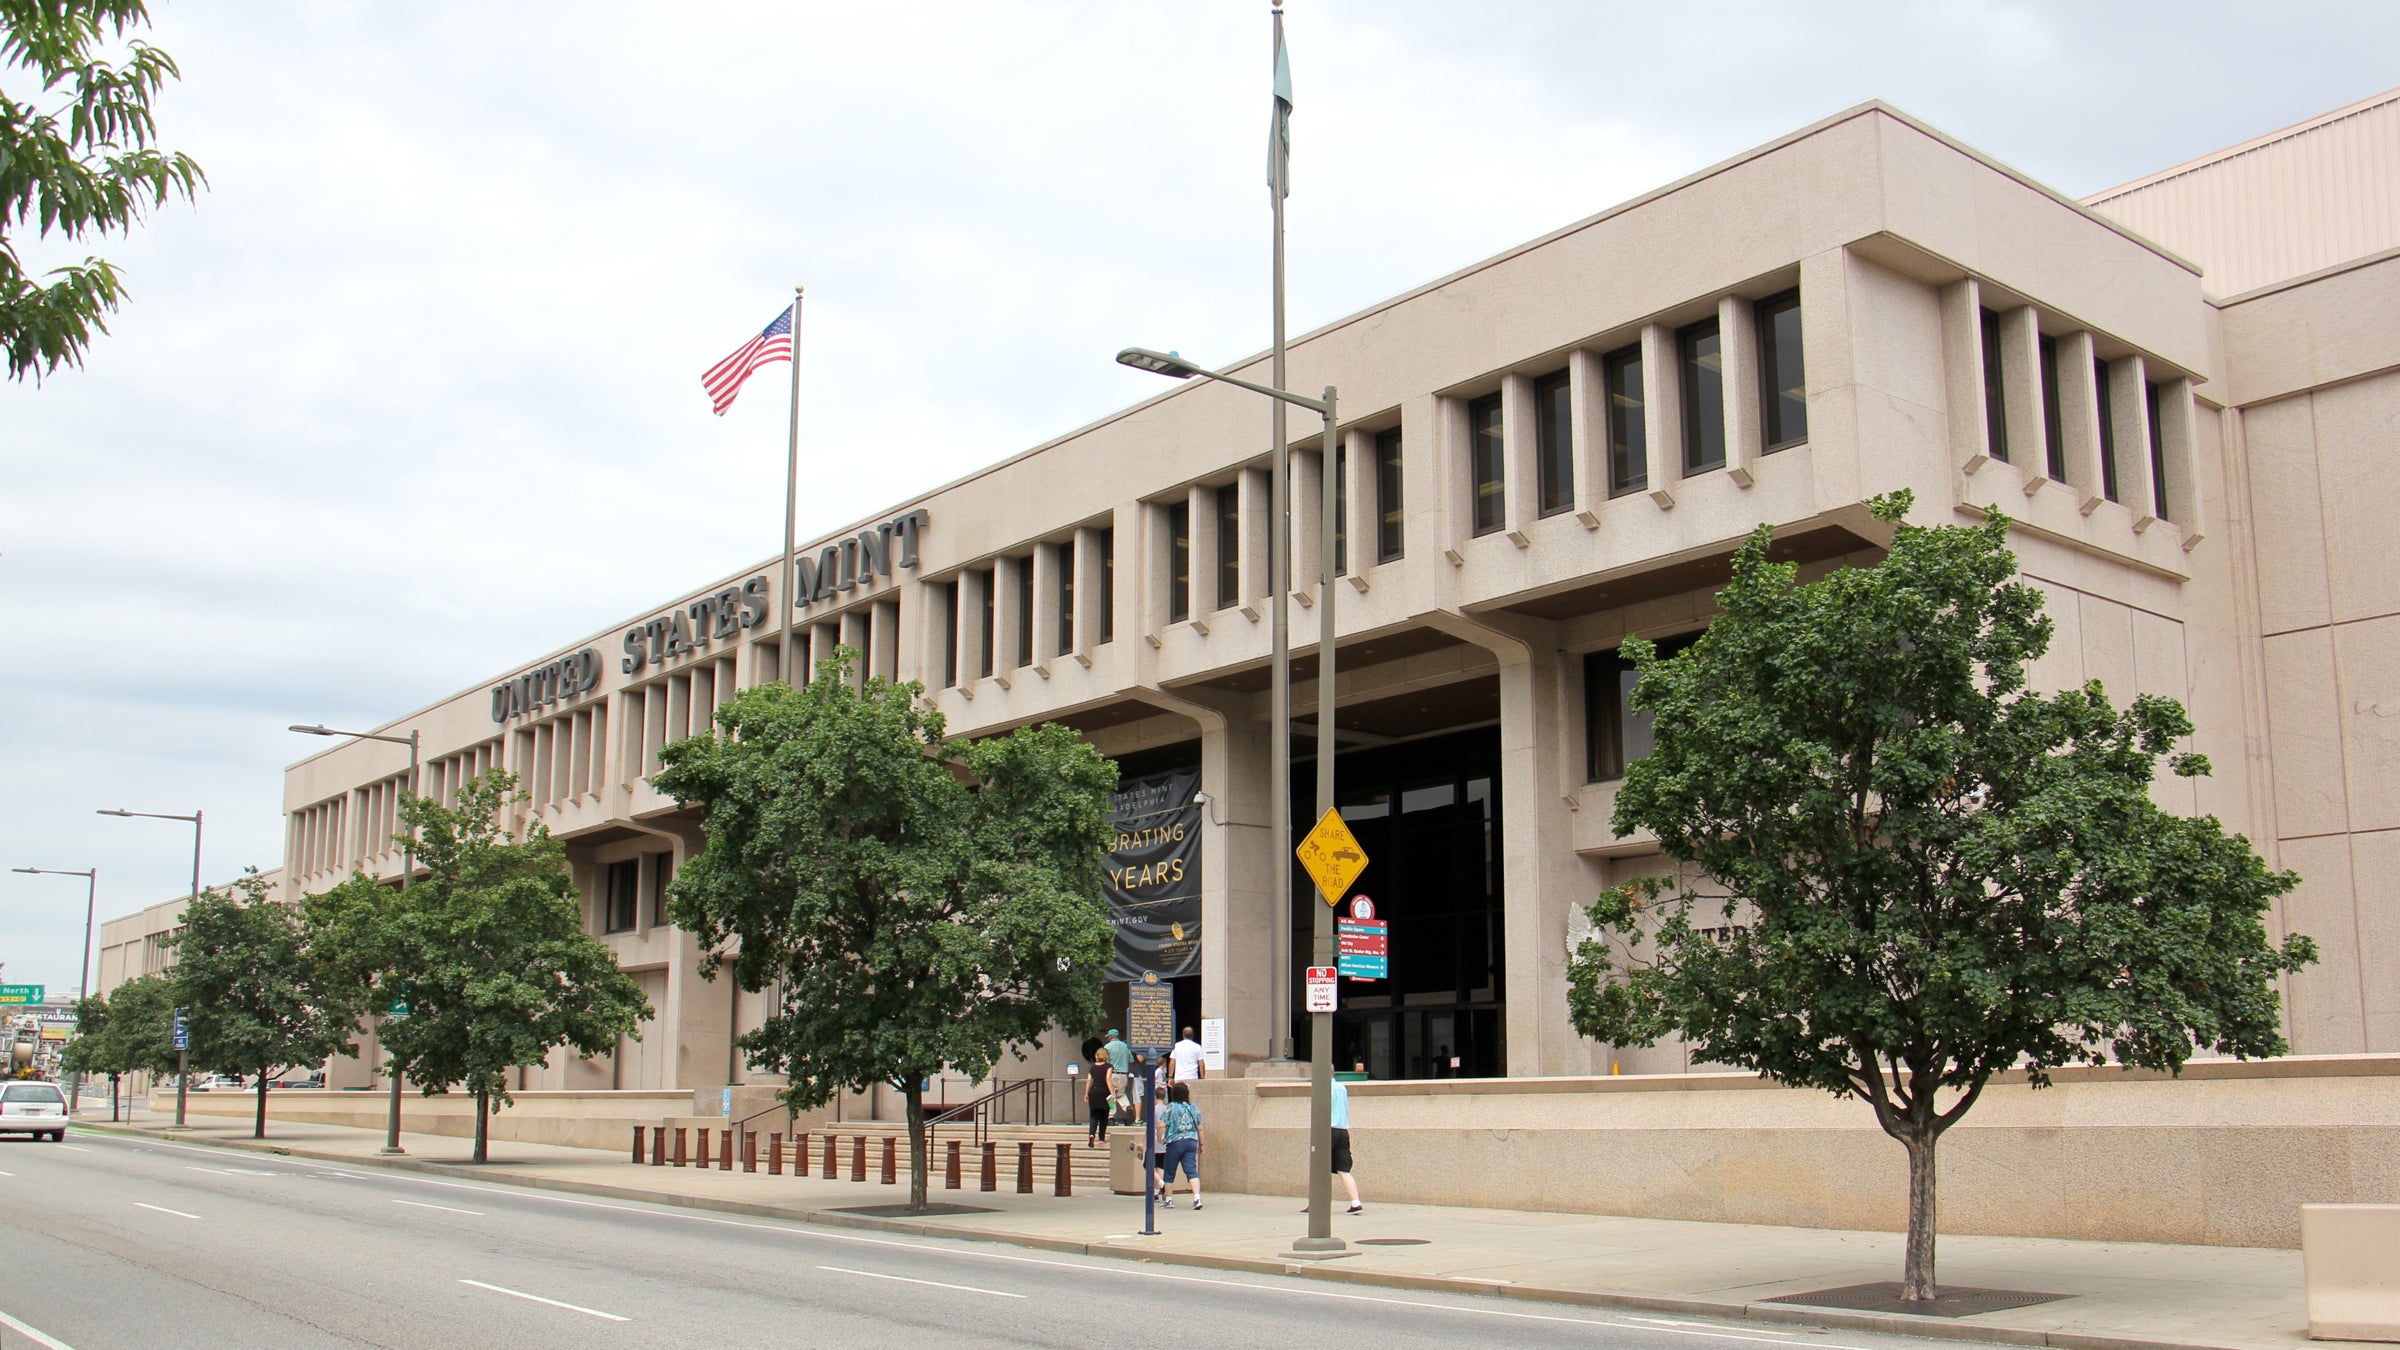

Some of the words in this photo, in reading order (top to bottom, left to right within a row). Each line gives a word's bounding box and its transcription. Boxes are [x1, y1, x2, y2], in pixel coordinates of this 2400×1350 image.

[491, 647, 600, 723] UNITED
[622, 575, 768, 674] STATES
[795, 508, 929, 608] MINT
[1113, 790, 1146, 800] STATES
[1151, 784, 1172, 795] MINT
[1320, 828, 1344, 841] SHARE
[1110, 859, 1183, 890] YEARS
[1326, 863, 1340, 875] THE
[1322, 876, 1344, 888] ROAD
[1316, 968, 1328, 978] NO
